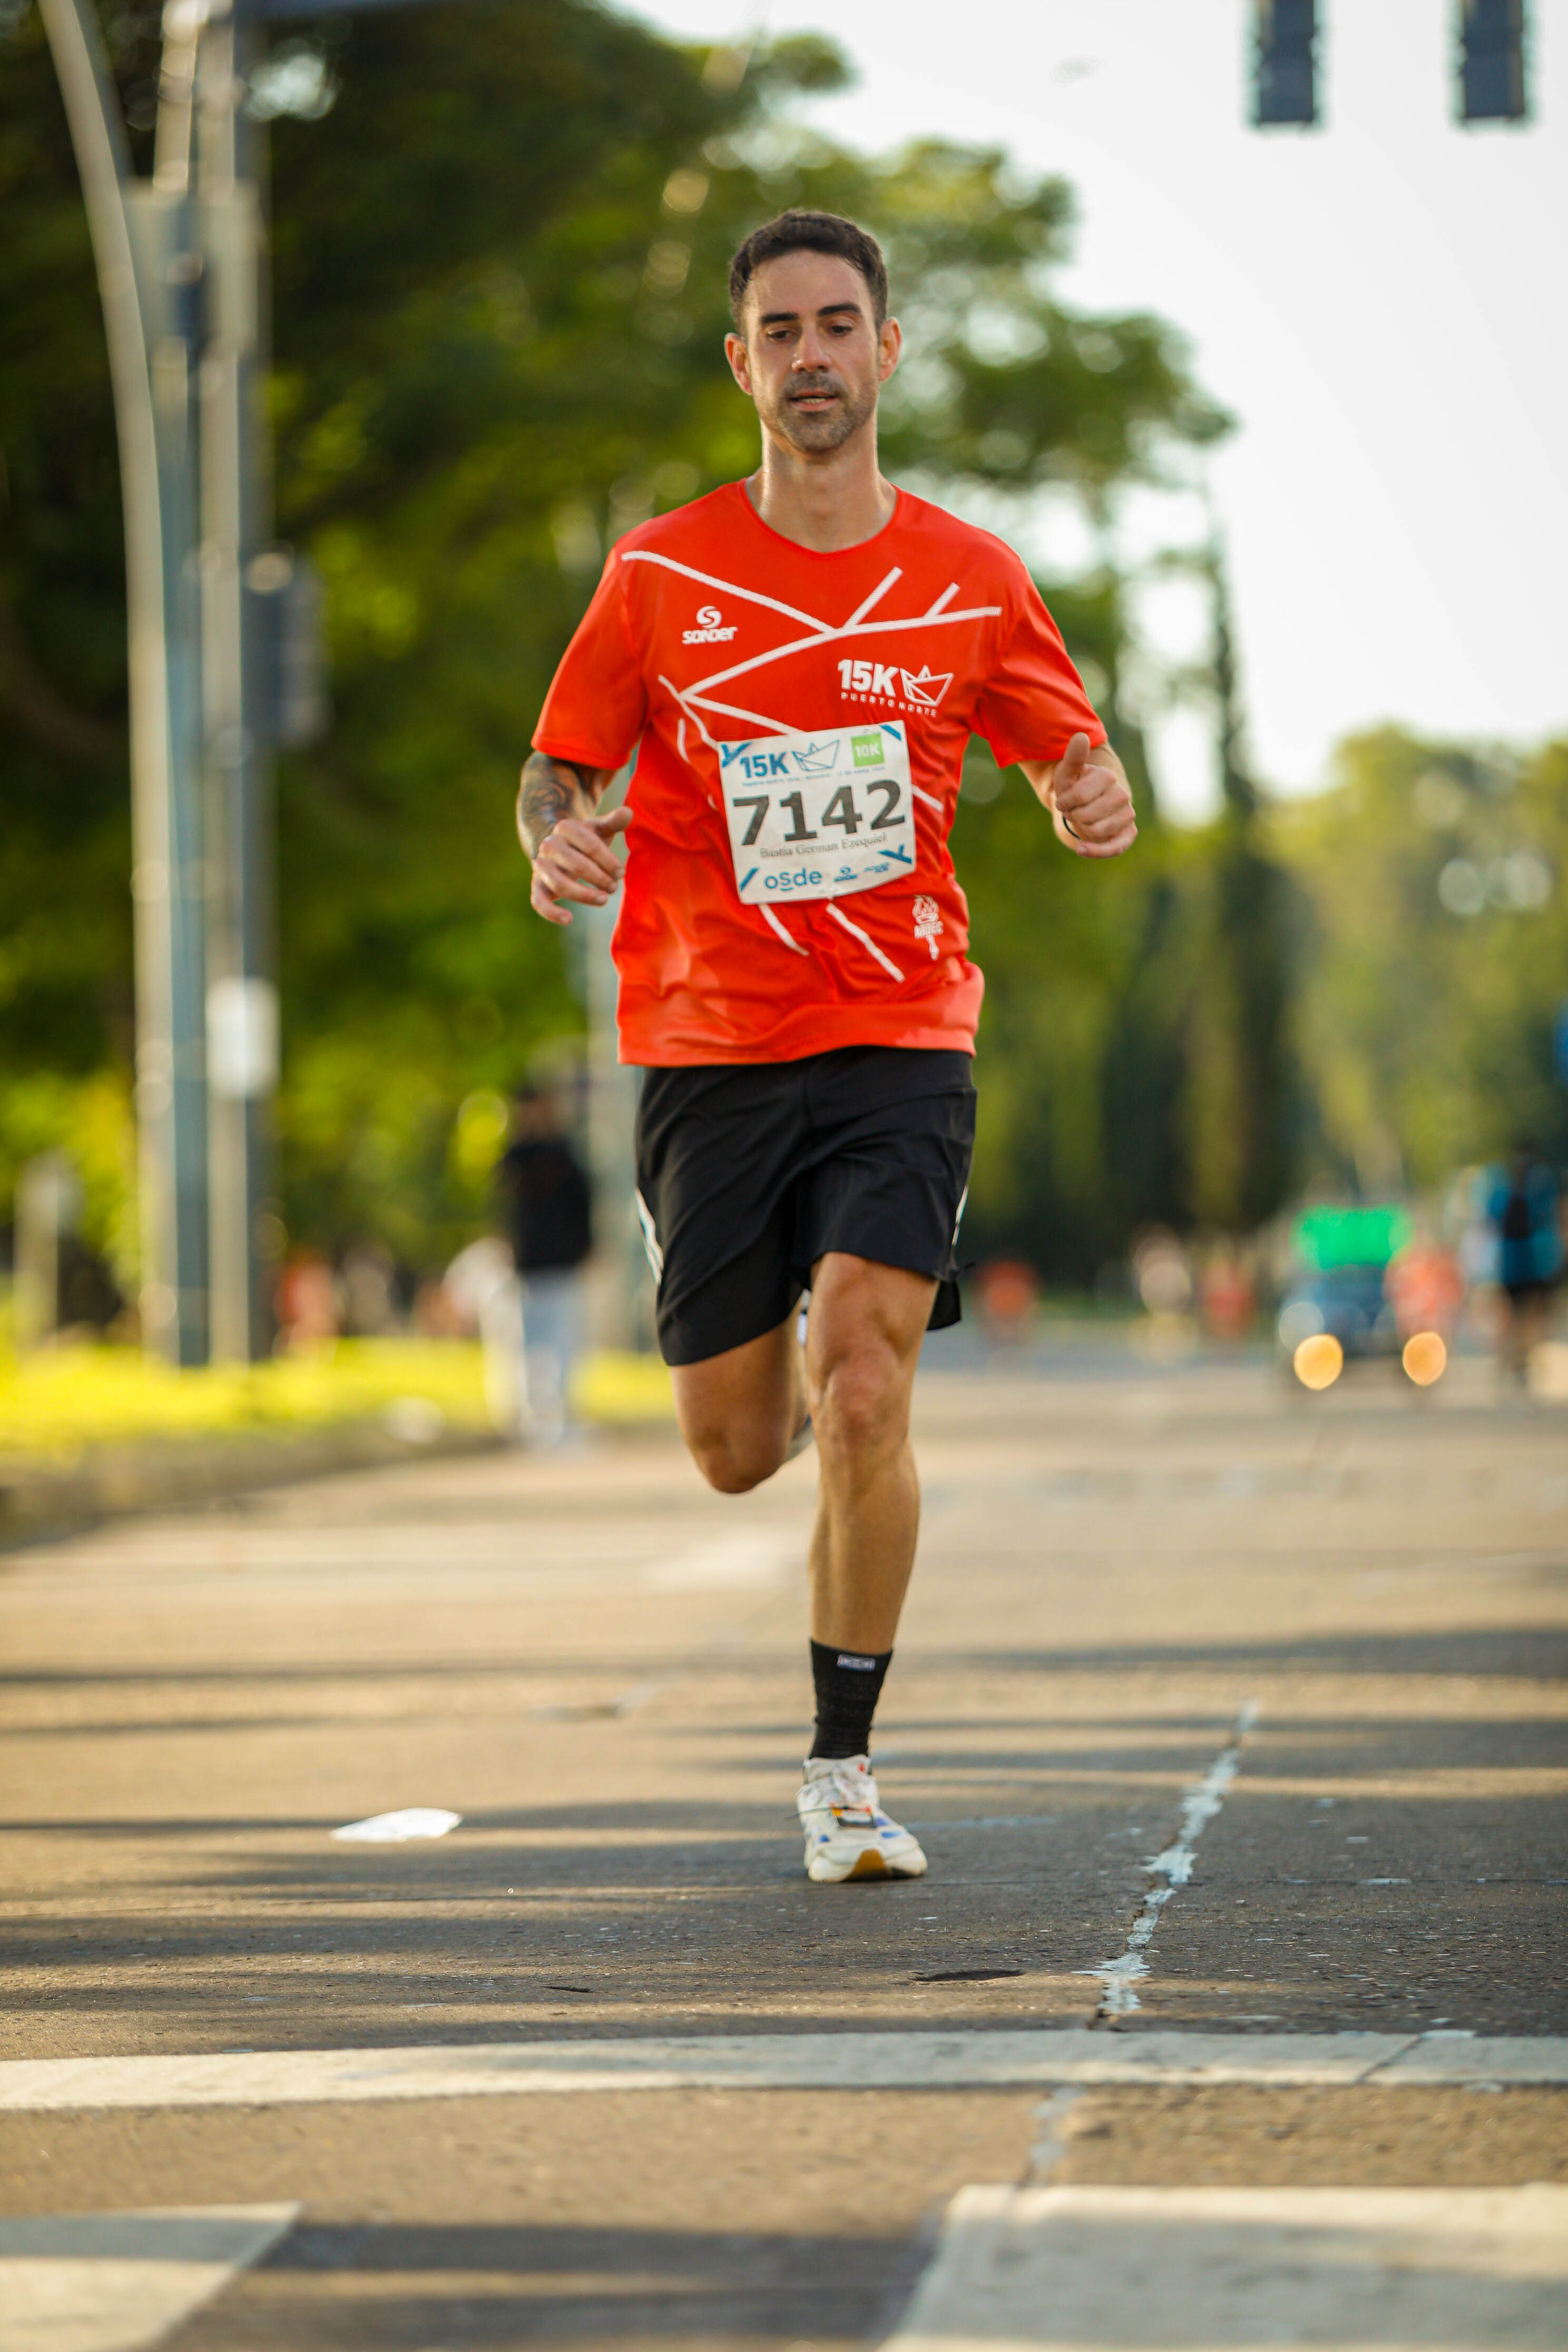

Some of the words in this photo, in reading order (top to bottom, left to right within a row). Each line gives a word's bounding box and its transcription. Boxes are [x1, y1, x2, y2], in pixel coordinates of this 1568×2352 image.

[838, 659, 899, 698] 15K
[841, 692, 895, 709] PUERTO
[898, 701, 936, 718] NORTE
[855, 744, 880, 758] 10K
[740, 751, 790, 778] 15K
[732, 779, 905, 846] 7142
[765, 867, 822, 890] osde
